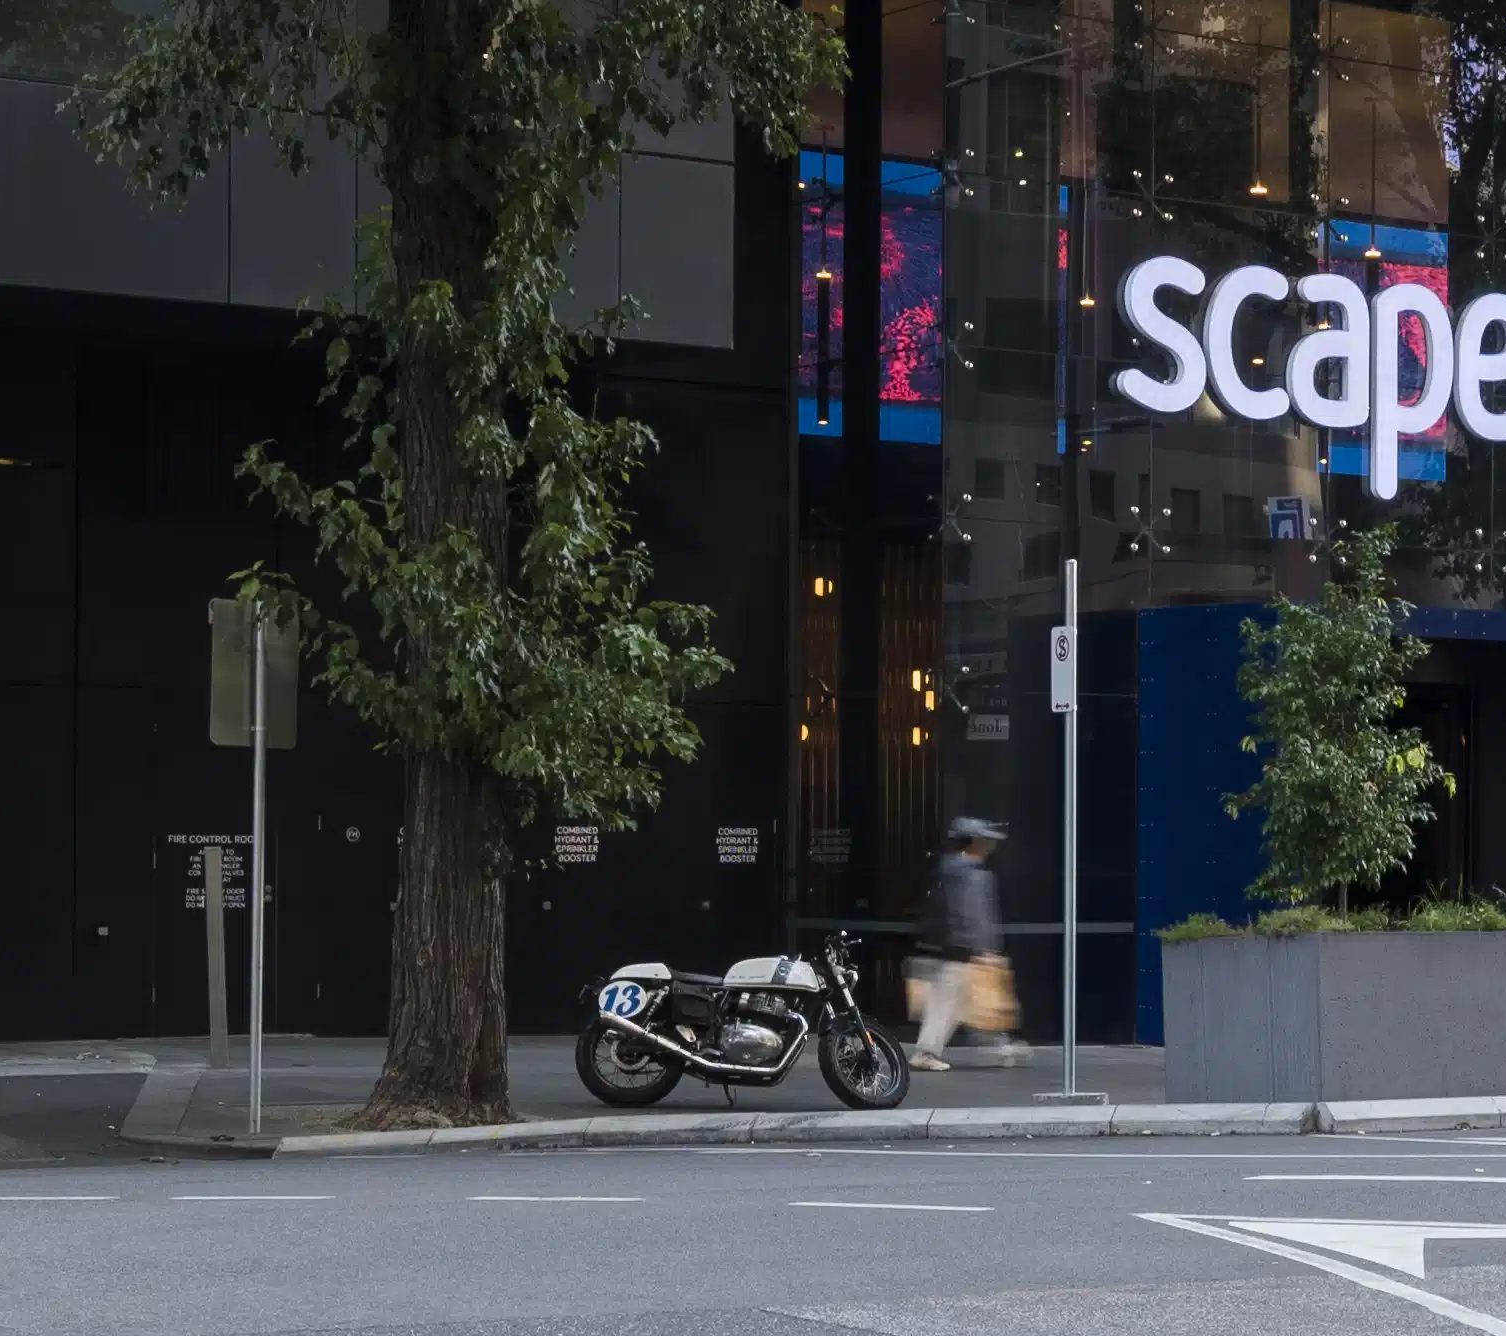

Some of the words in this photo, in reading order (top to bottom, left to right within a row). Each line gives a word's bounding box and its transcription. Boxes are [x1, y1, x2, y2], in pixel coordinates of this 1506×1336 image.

[556, 826, 599, 834] COMBINED
[717, 827, 758, 836] COMBINED
[167, 834, 187, 844] FIRE
[188, 834, 233, 844] CONTROL
[234, 834, 254, 844] ROO
[554, 835, 592, 844] HYDRANT
[715, 836, 751, 845] HYDRANT
[558, 853, 597, 862] BOOSTER
[719, 854, 756, 863] BOOSTER
[603, 984, 642, 1018] 13
